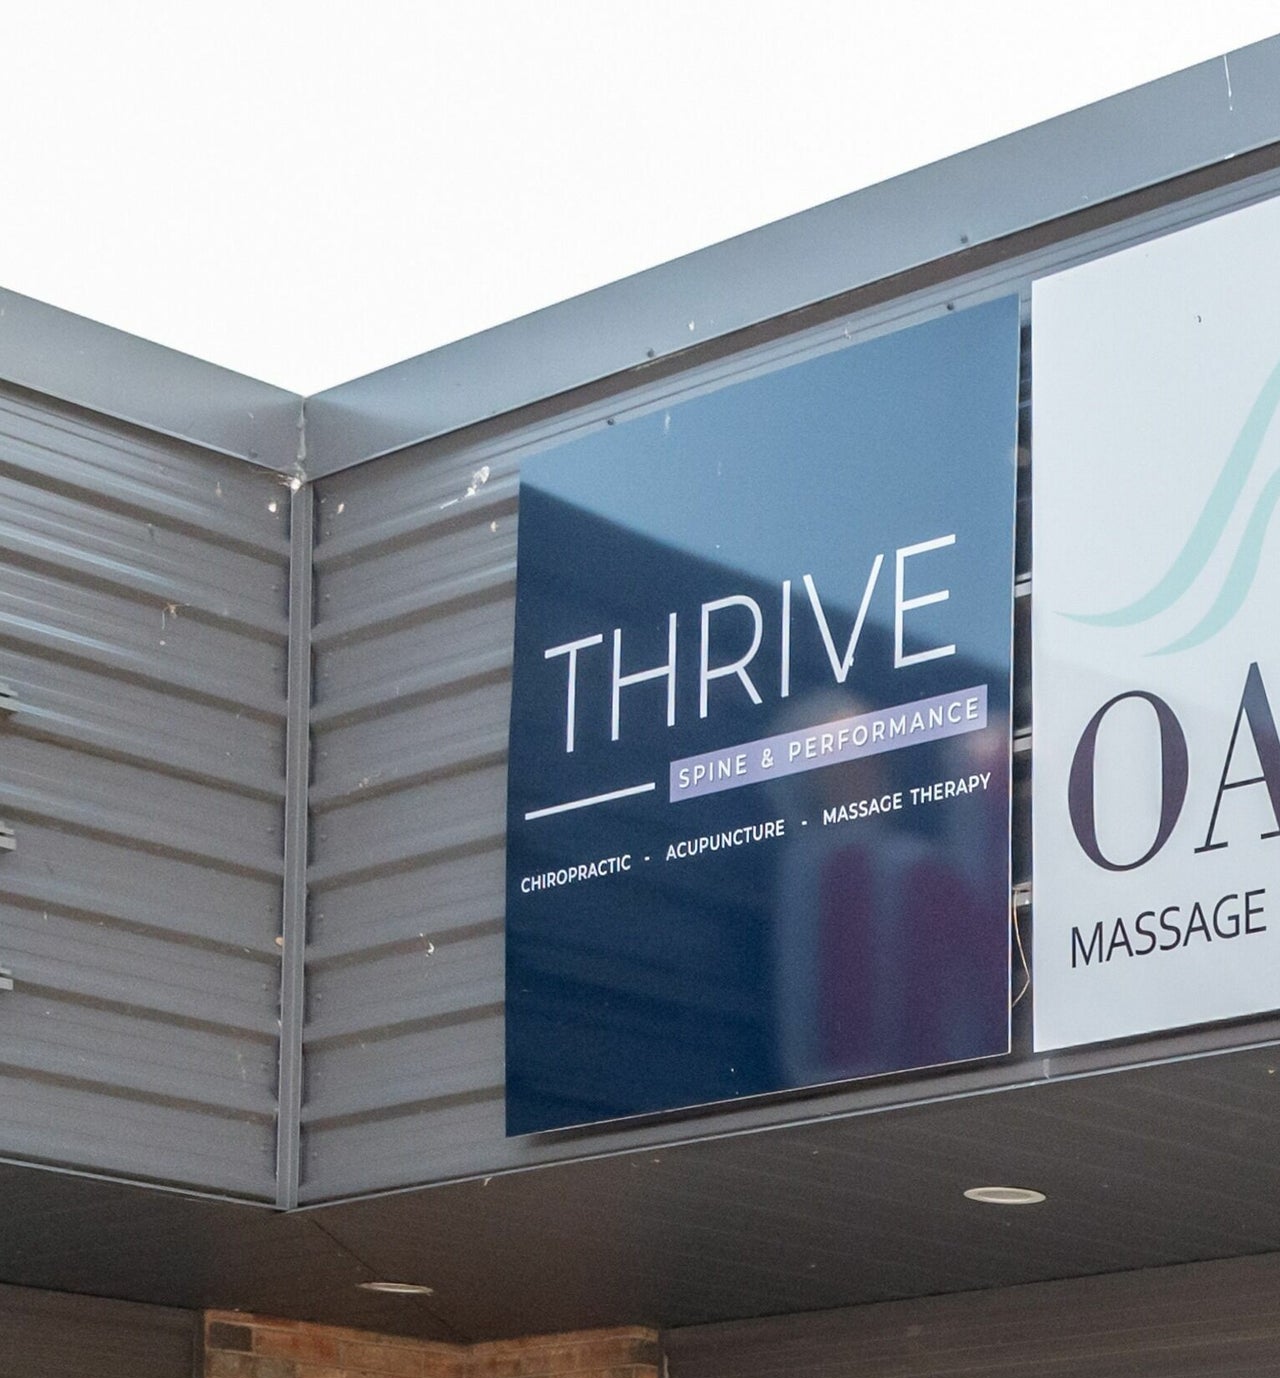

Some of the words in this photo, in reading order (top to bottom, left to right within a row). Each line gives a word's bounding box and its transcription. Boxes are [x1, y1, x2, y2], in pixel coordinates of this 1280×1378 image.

[544, 534, 956, 752] THRIVE
[679, 753, 747, 790] SPINE
[761, 748, 774, 768] &
[788, 697, 980, 762] PERFORMANCE
[521, 854, 632, 893] CHIROPRACTIC
[666, 819, 785, 862] ACUPUNCTURE
[823, 792, 903, 826] MASSAGE
[910, 772, 992, 806] THERAPY
[1071, 888, 1267, 969] MASSAGE
